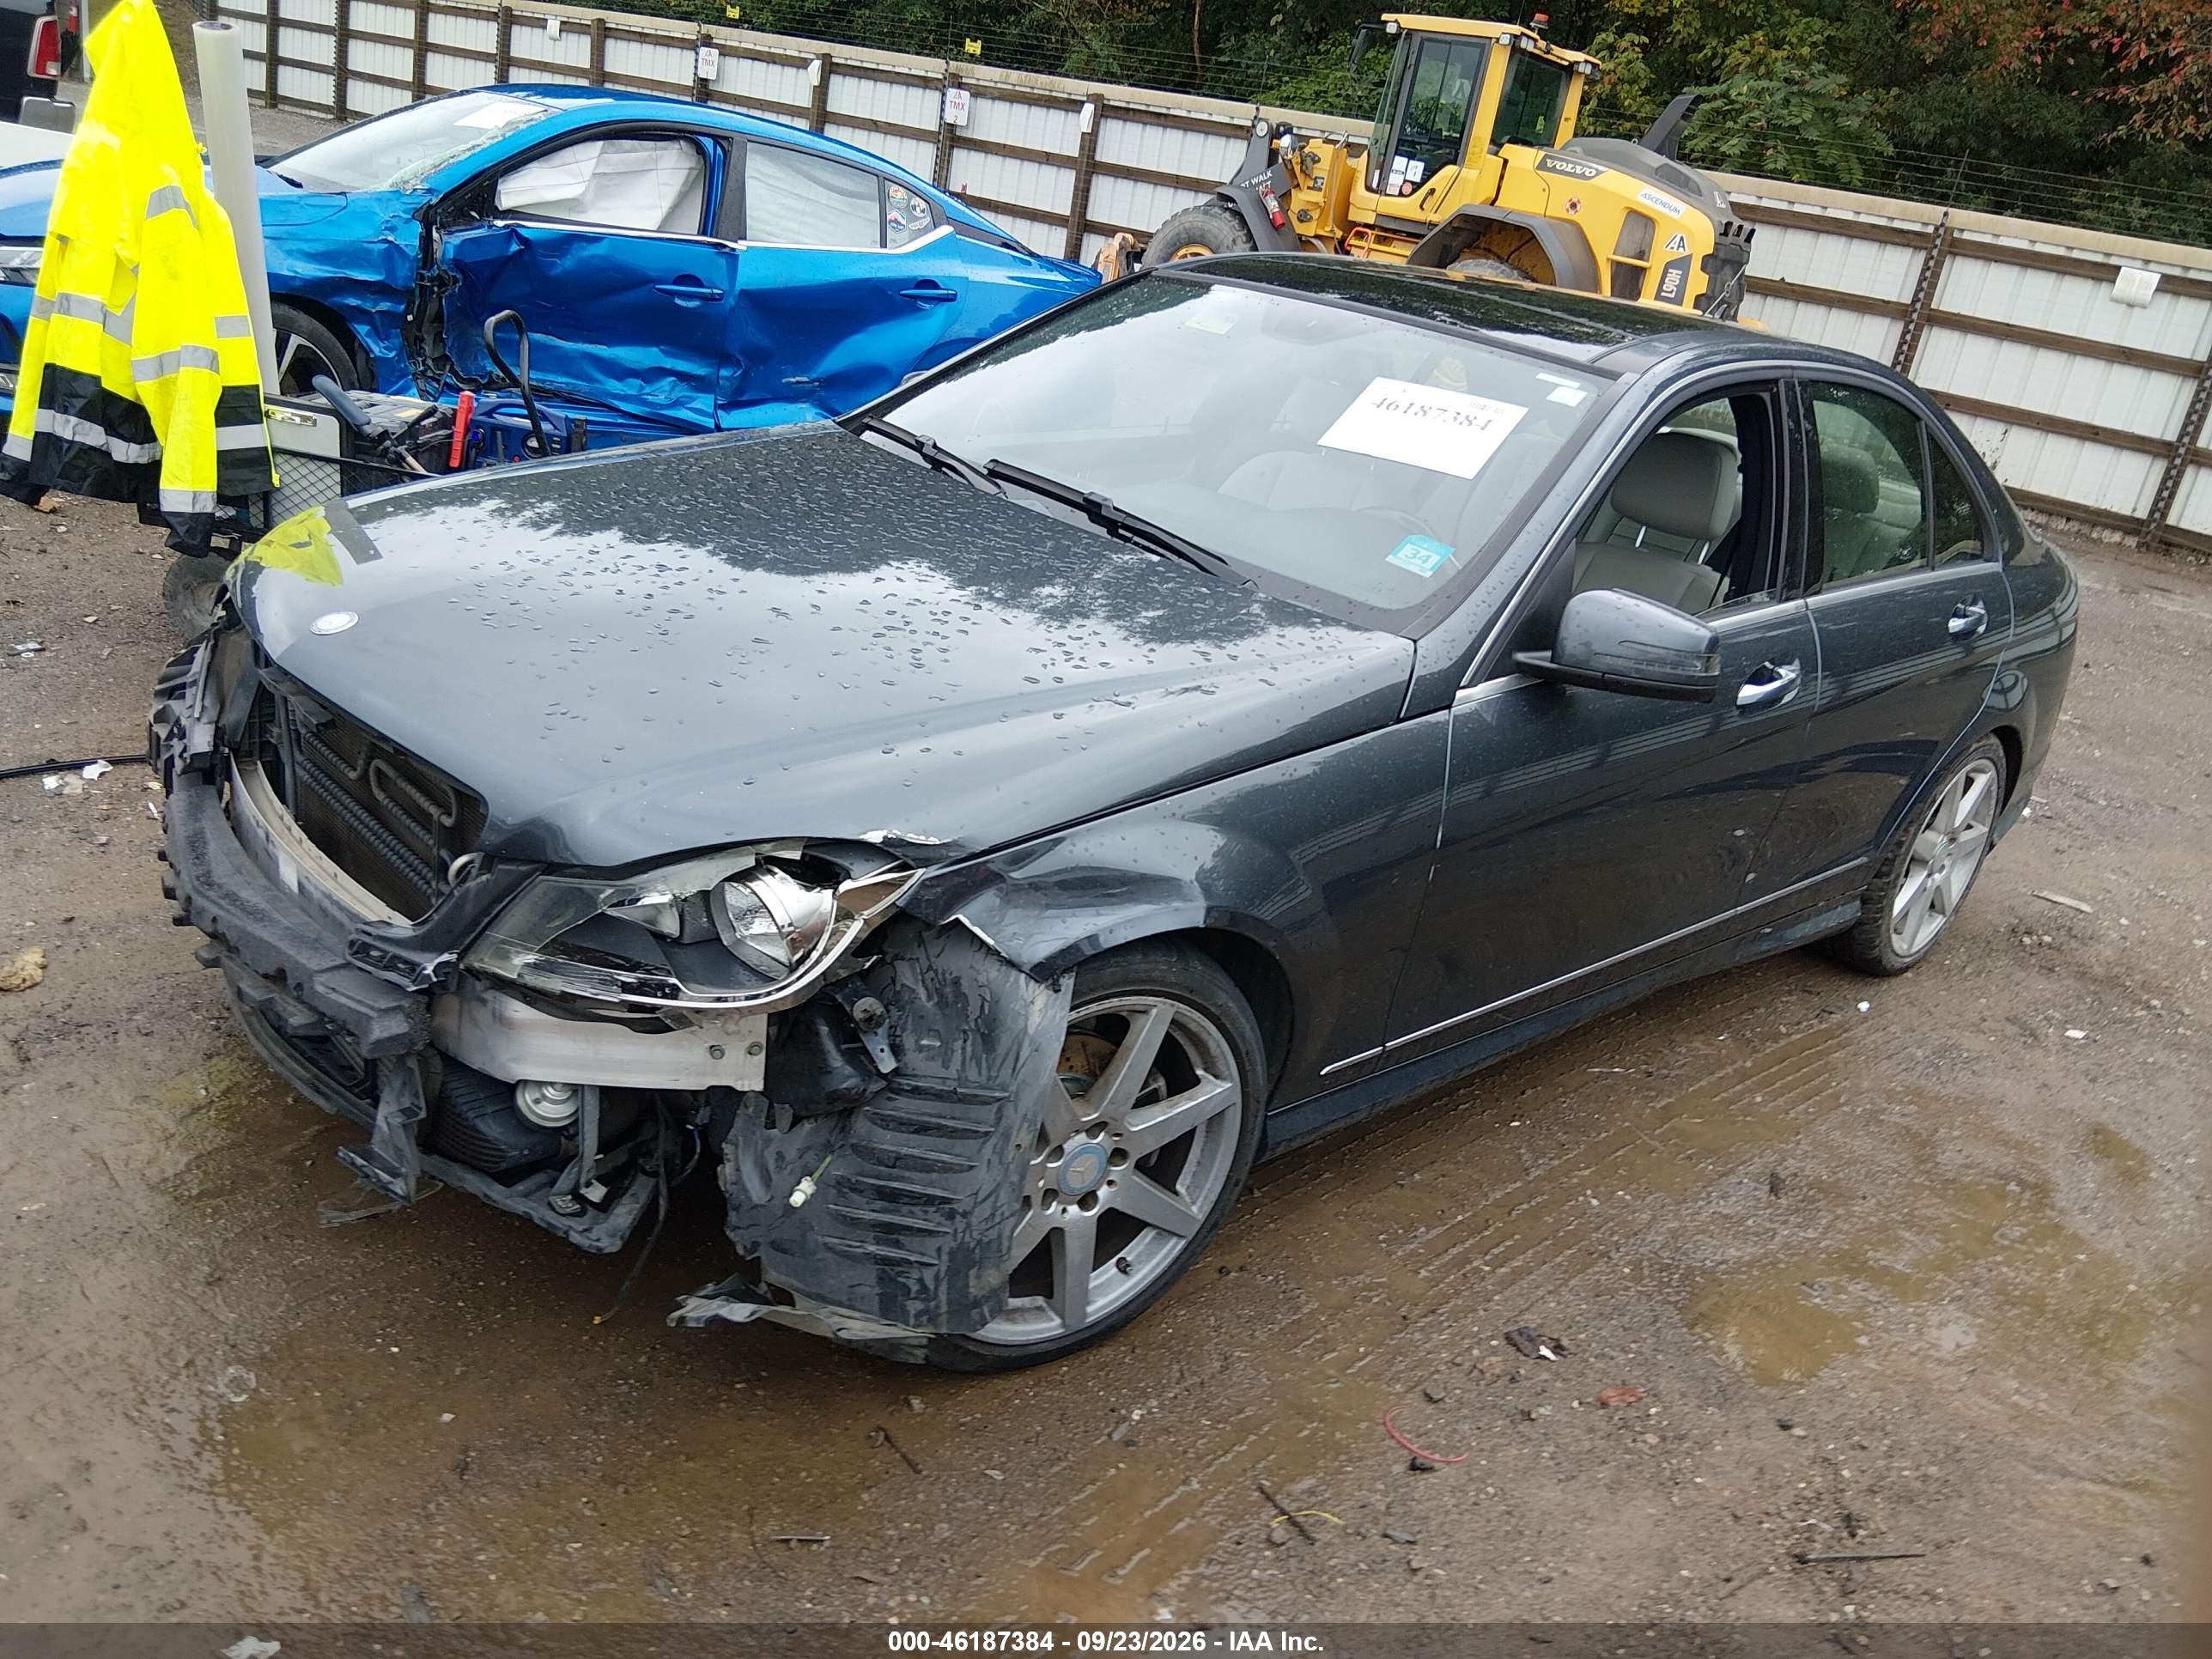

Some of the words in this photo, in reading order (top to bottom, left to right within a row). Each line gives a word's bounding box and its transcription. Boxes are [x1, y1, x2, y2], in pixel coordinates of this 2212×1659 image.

[702, 58, 715, 68] TMX
[950, 100, 966, 112] TMX
[953, 115, 958, 124] 2
[1545, 158, 1597, 177] VOLVO
[1250, 169, 1273, 185] WALK
[1640, 191, 1681, 216] ASCENDUM
[1660, 269, 1683, 298] L90H
[1370, 396, 1493, 431] 46187384
[1404, 547, 1432, 564] 34
